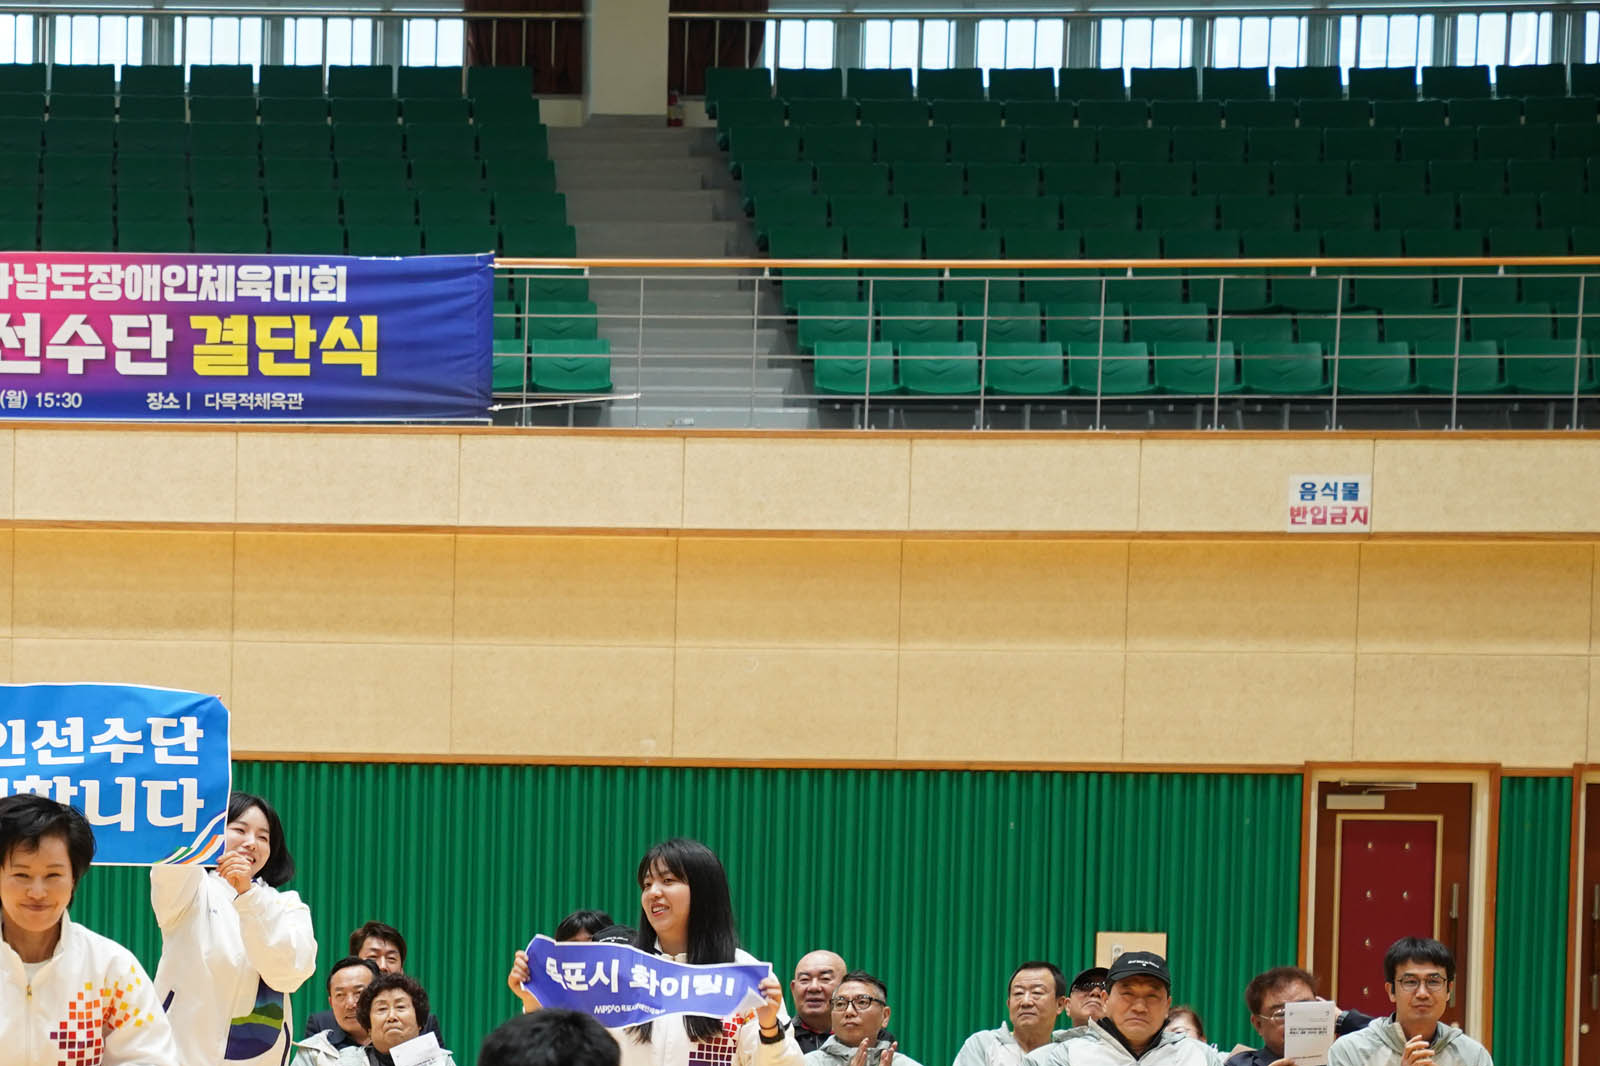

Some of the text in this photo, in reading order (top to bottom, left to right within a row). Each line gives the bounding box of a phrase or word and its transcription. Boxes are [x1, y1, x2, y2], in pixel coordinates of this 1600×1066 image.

[189, 315, 378, 377] 결단식
[35, 391, 83, 409] 15:30
[146, 392, 180, 410] 장소
[204, 393, 304, 411] 다목적체육관
[1299, 482, 1359, 501] 음식물
[1289, 505, 1369, 526] 반입금지
